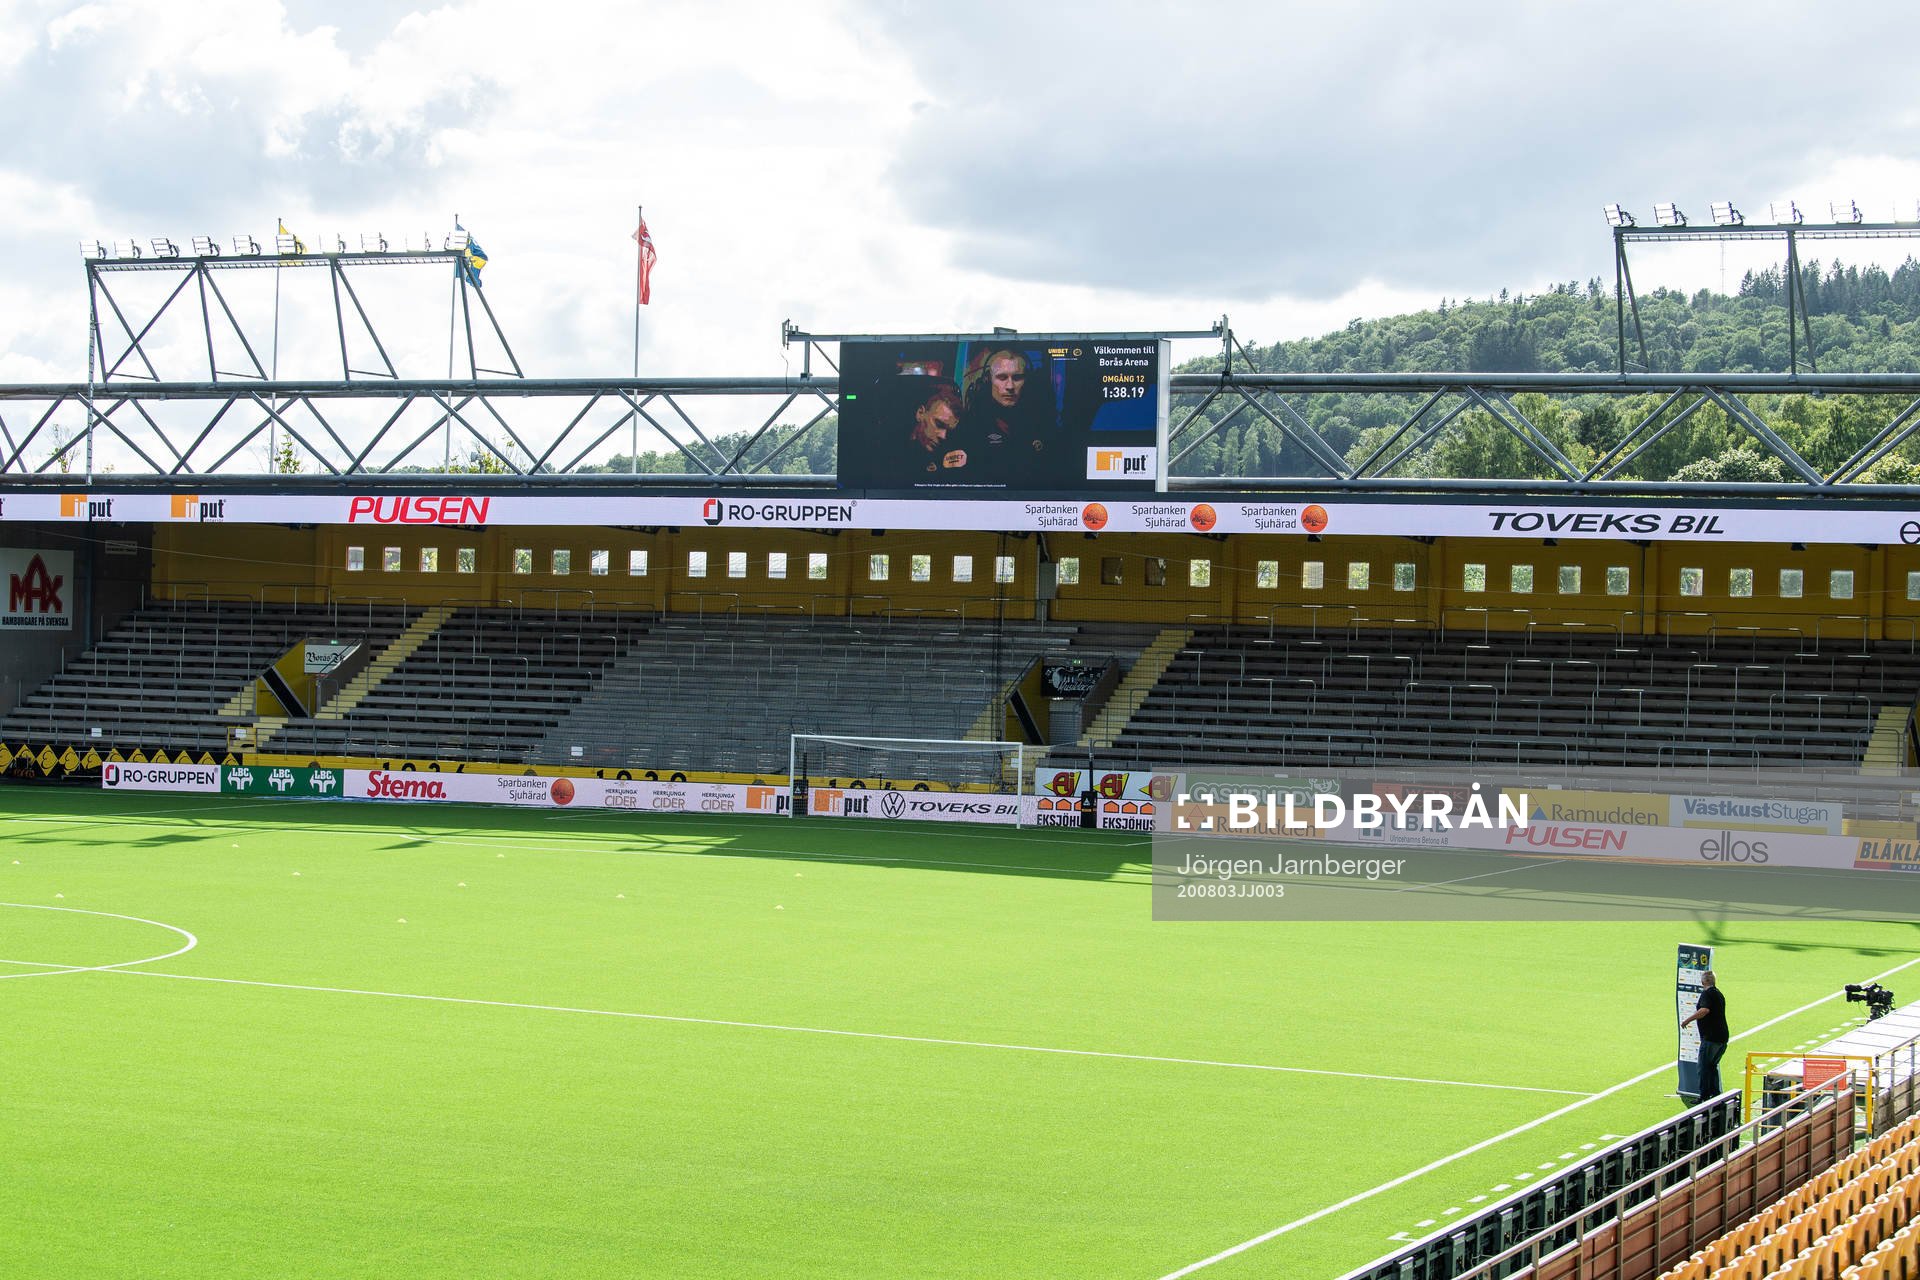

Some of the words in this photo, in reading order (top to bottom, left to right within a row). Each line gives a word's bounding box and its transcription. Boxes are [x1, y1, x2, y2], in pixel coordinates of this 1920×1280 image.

[1094, 346, 1141, 355] Välkommen
[1143, 346, 1155, 354] till
[1099, 357, 1123, 366] Borås
[1124, 358, 1149, 366] Arena
[1102, 373, 1135, 383] OMGÅNG
[1136, 375, 1145, 383] 12
[1102, 386, 1145, 398] 1:38.19
[348, 496, 490, 524] PULSEN
[728, 504, 852, 522] RO-GRUPPEN
[1025, 504, 1078, 515] Sparbanken
[1131, 505, 1186, 516] Sparbanken
[1241, 506, 1297, 517] Sparbanken
[1037, 516, 1078, 528] Sjuhärad
[1145, 517, 1186, 529] Sjuhärad
[1254, 518, 1297, 530] Sjuhärad
[1488, 512, 1661, 534] TOVEKS
[1668, 515, 1725, 535] BIL
[9, 553, 64, 613] MAX
[123, 769, 215, 784] RO-GRUPPEN
[232, 767, 250, 777] LBC
[273, 768, 291, 778] LBC
[314, 770, 332, 780] LBC
[367, 770, 447, 799] Stema.
[497, 777, 547, 790] Sparbanken
[509, 790, 547, 801] Sjuhärad
[605, 795, 637, 808] CIDER
[652, 797, 685, 809] CIDER
[701, 799, 734, 812] CIDER
[909, 801, 991, 814] TOVEKS
[994, 804, 1018, 815] BIL
[1036, 812, 1080, 827] EKSJÖH
[1551, 803, 1658, 825] Ramudden
[1102, 816, 1156, 831] EKSJÖHUS
[1505, 825, 1627, 850] PULSEN
[1700, 831, 1769, 863] ellos
